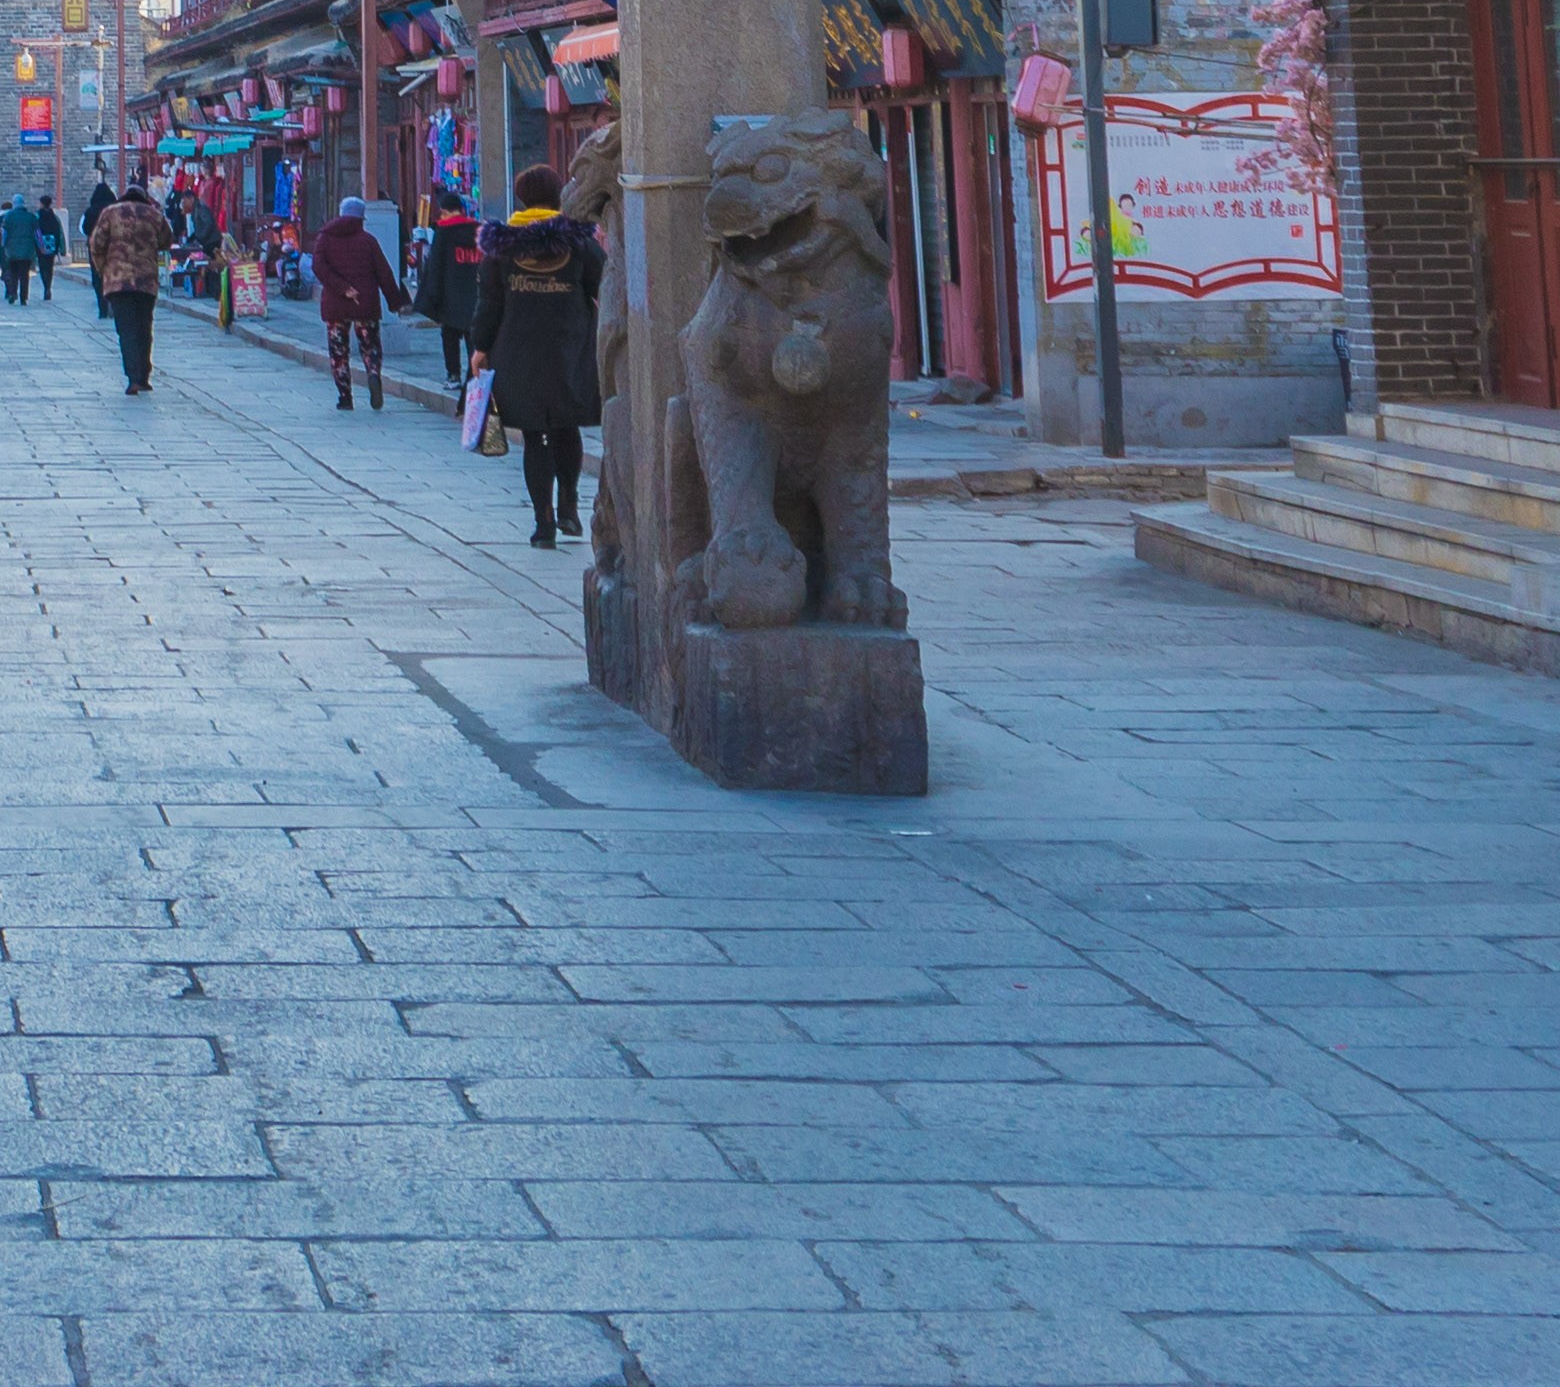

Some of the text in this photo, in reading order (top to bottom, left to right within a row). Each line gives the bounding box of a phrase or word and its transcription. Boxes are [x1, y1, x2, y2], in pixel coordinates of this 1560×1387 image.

[1142, 197, 1310, 219] 推进未成年人思想道德建设
